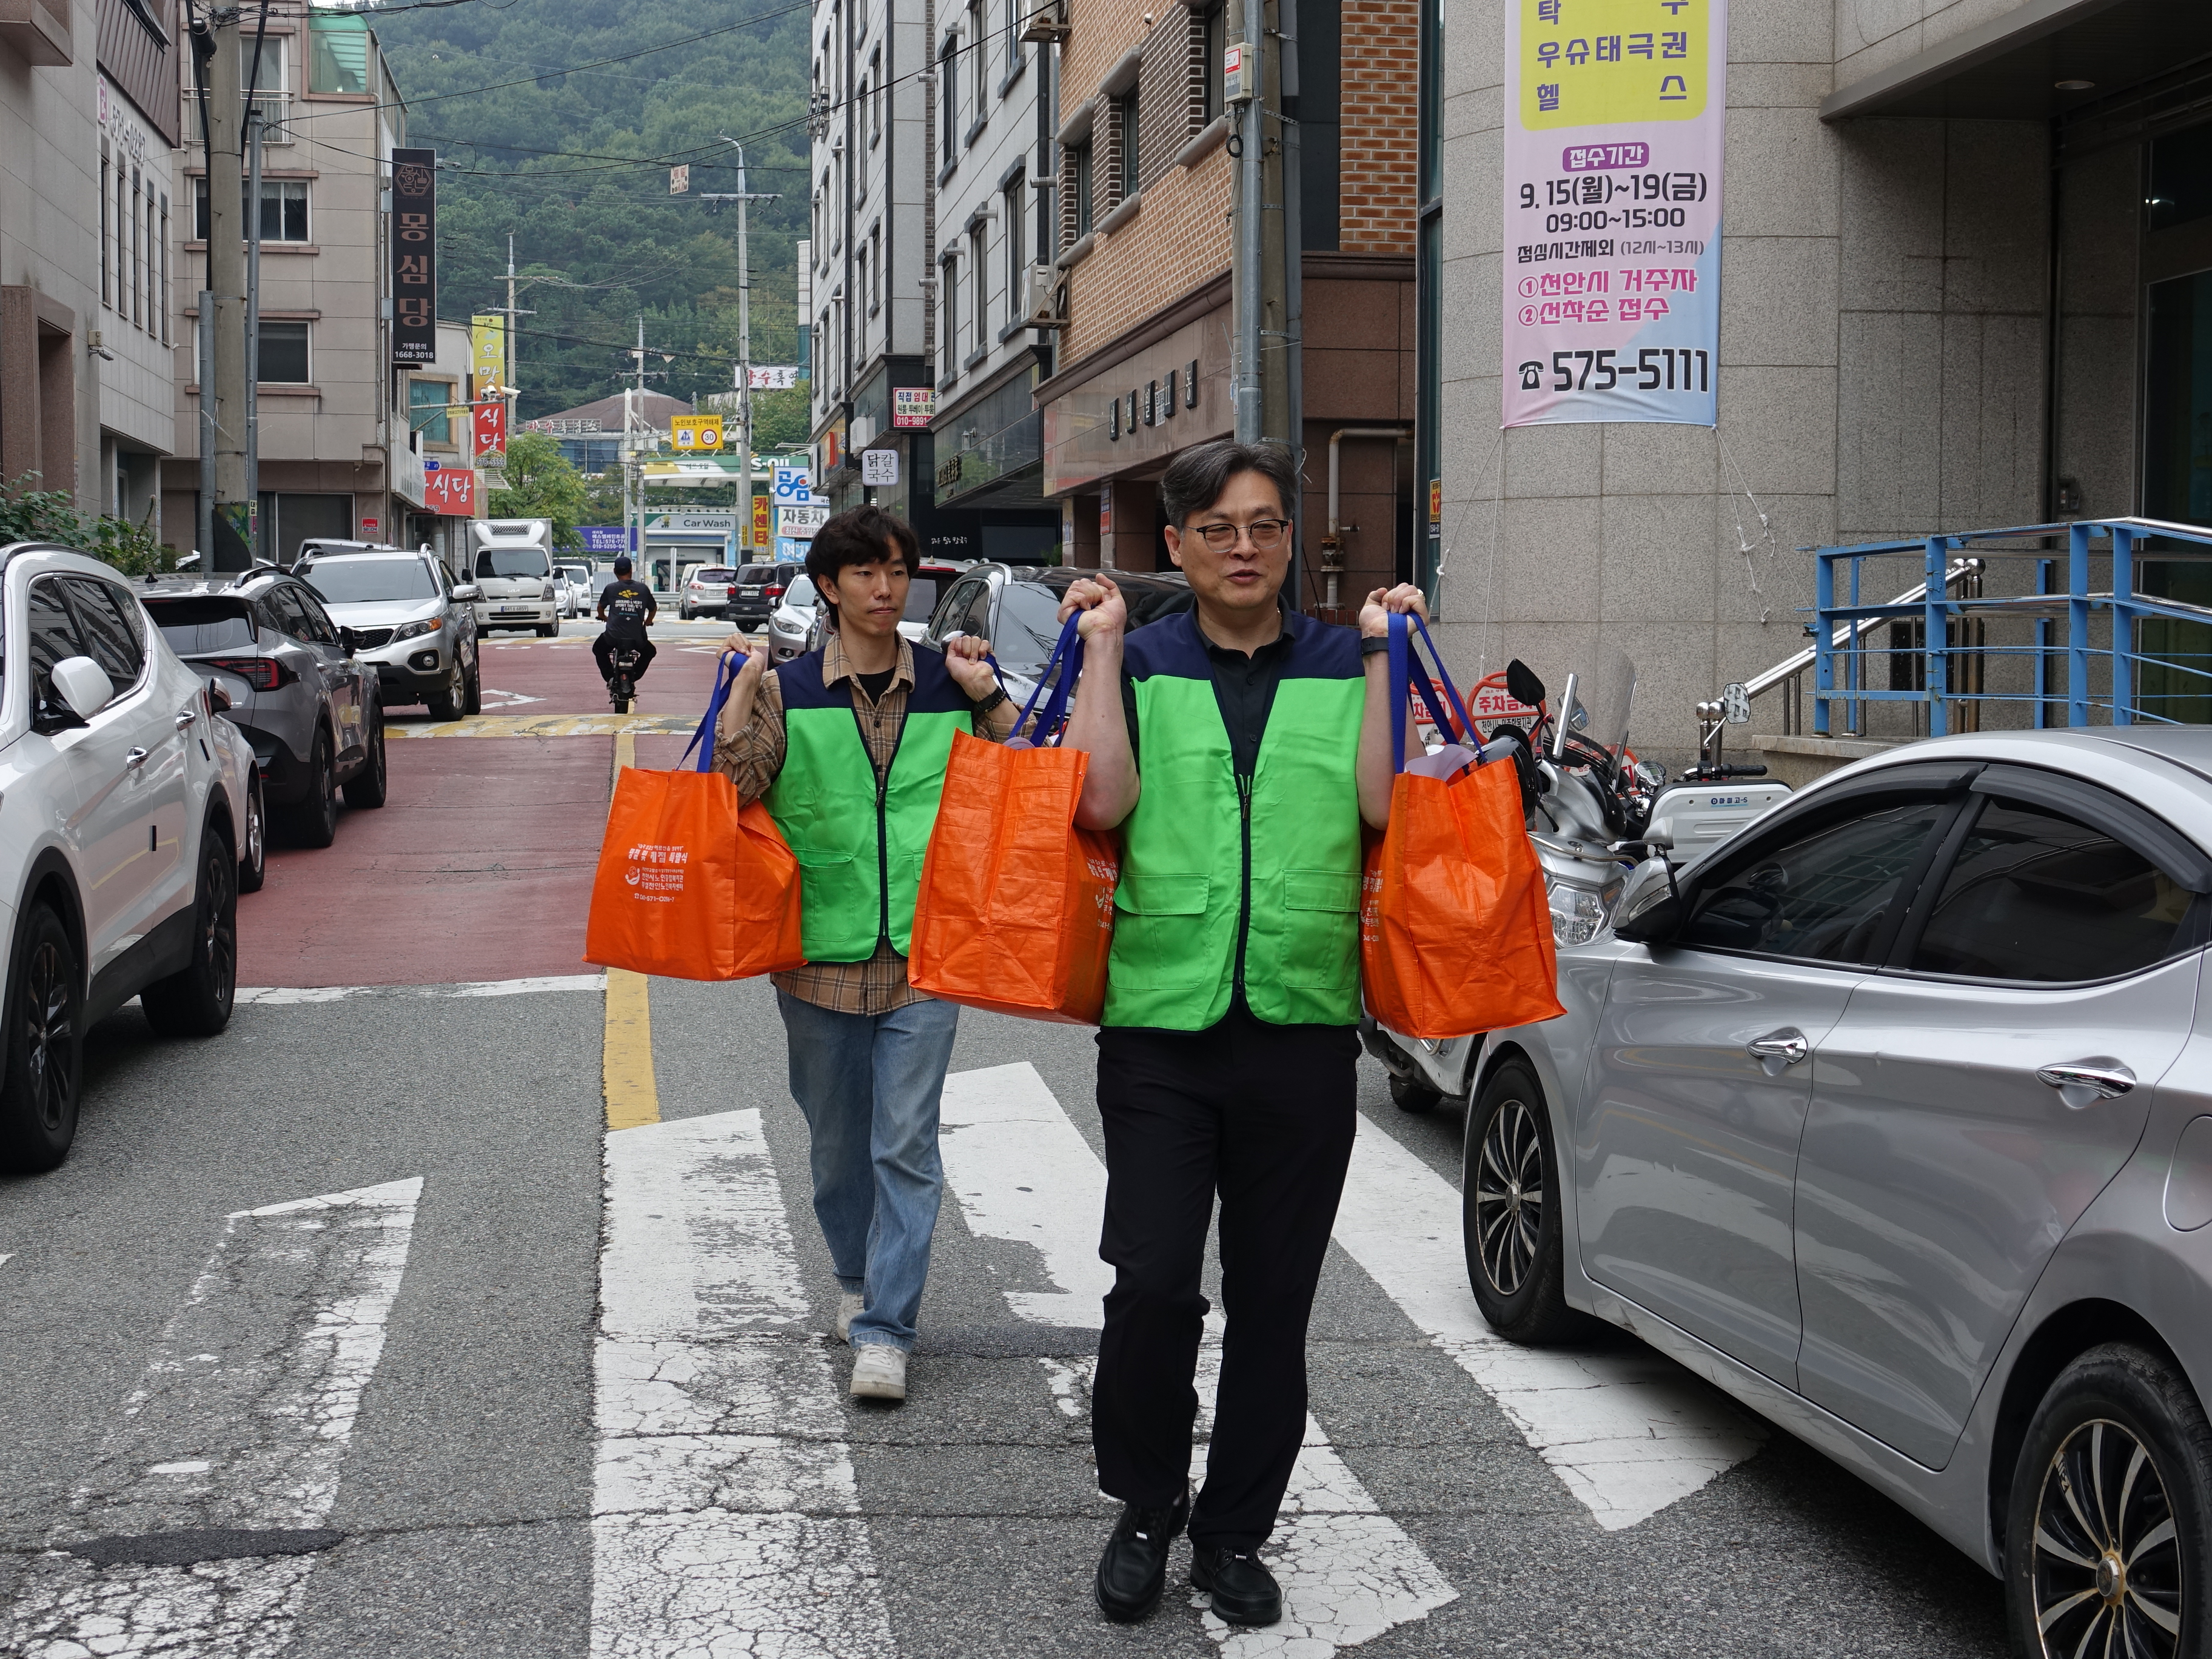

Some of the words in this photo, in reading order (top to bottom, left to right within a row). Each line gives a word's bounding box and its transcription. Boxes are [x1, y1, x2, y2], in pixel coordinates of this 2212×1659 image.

[1537, 32, 1687, 69] 우슈태극권
[1570, 146, 1644, 169] 접수기간
[1546, 207, 1685, 233] 09:00~15:00
[1518, 240, 1614, 263] 점심시간제외
[1620, 240, 1704, 256] (12시~13시)
[397, 213, 432, 327] 몽심당
[1619, 269, 1698, 292] 거주자
[1618, 297, 1670, 321] 접수
[1553, 349, 1709, 392] 575-5111
[898, 392, 912, 403] 직접
[914, 392, 928, 403] 임대
[424, 474, 471, 503] 식당
[754, 497, 768, 545] 카센타
[783, 509, 825, 525] 자동차
